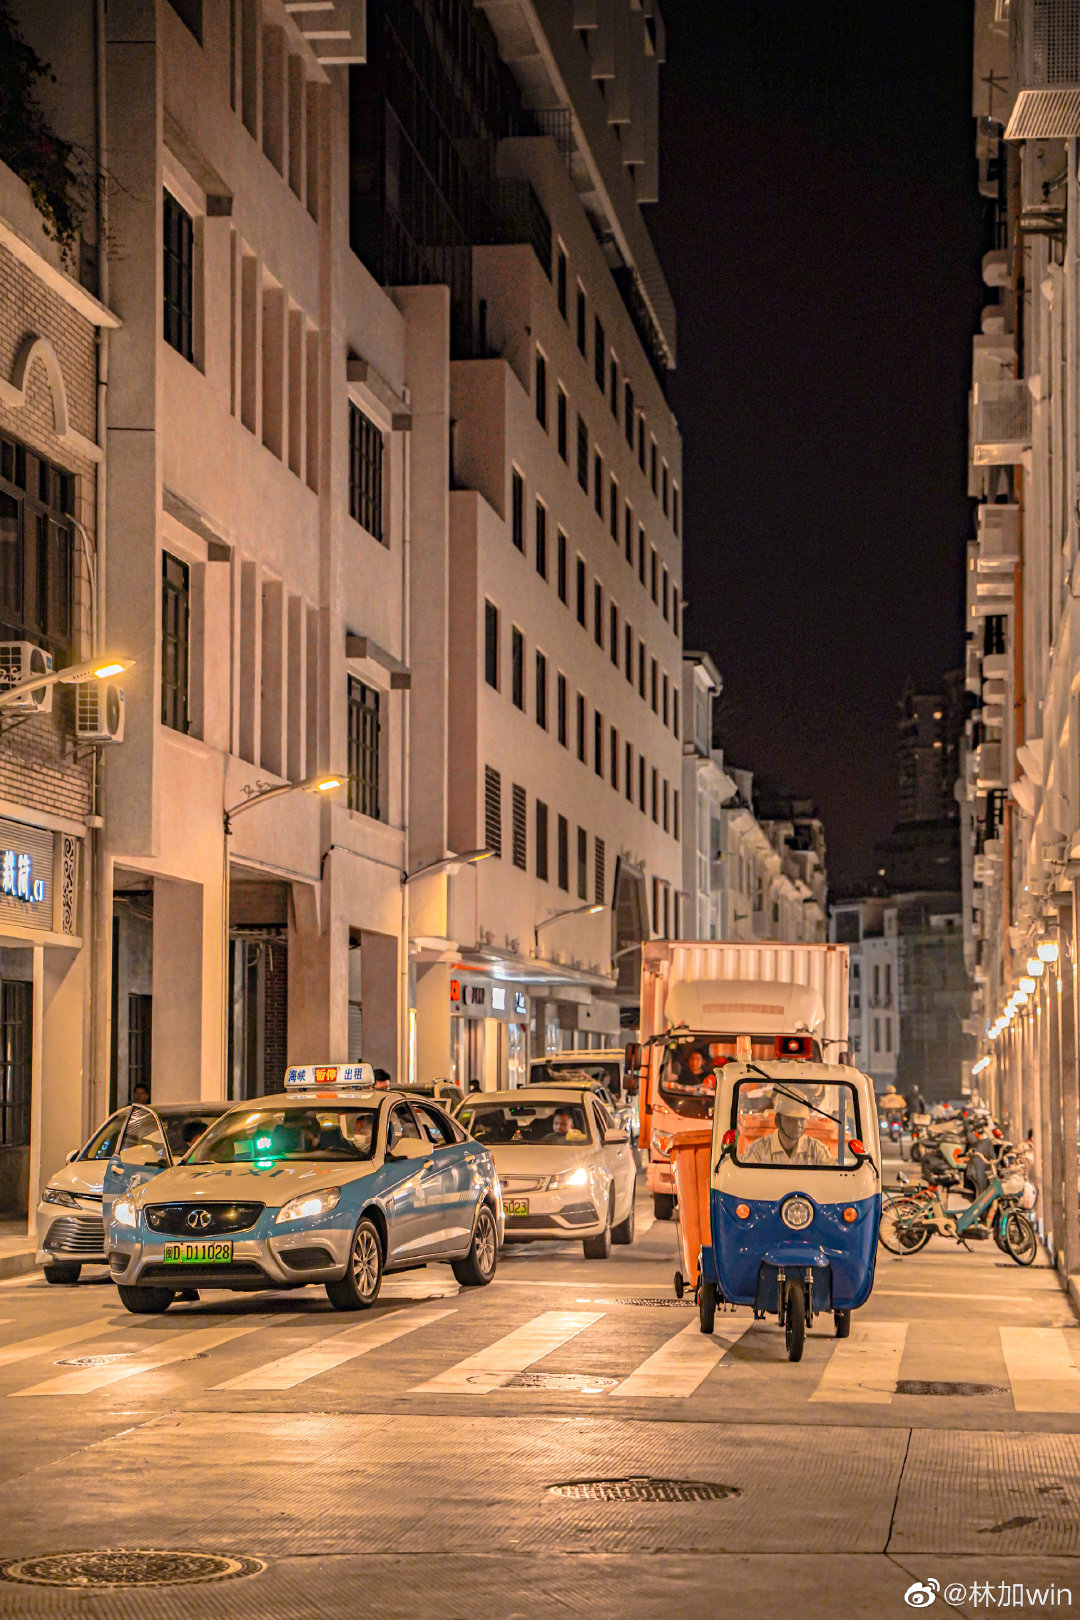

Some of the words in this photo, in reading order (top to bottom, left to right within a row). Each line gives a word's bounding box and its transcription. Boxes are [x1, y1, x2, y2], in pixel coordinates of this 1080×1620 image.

[288, 1069, 307, 1083] 海峡
[315, 1068, 337, 1081] 暂停
[344, 1067, 363, 1080] 出租
